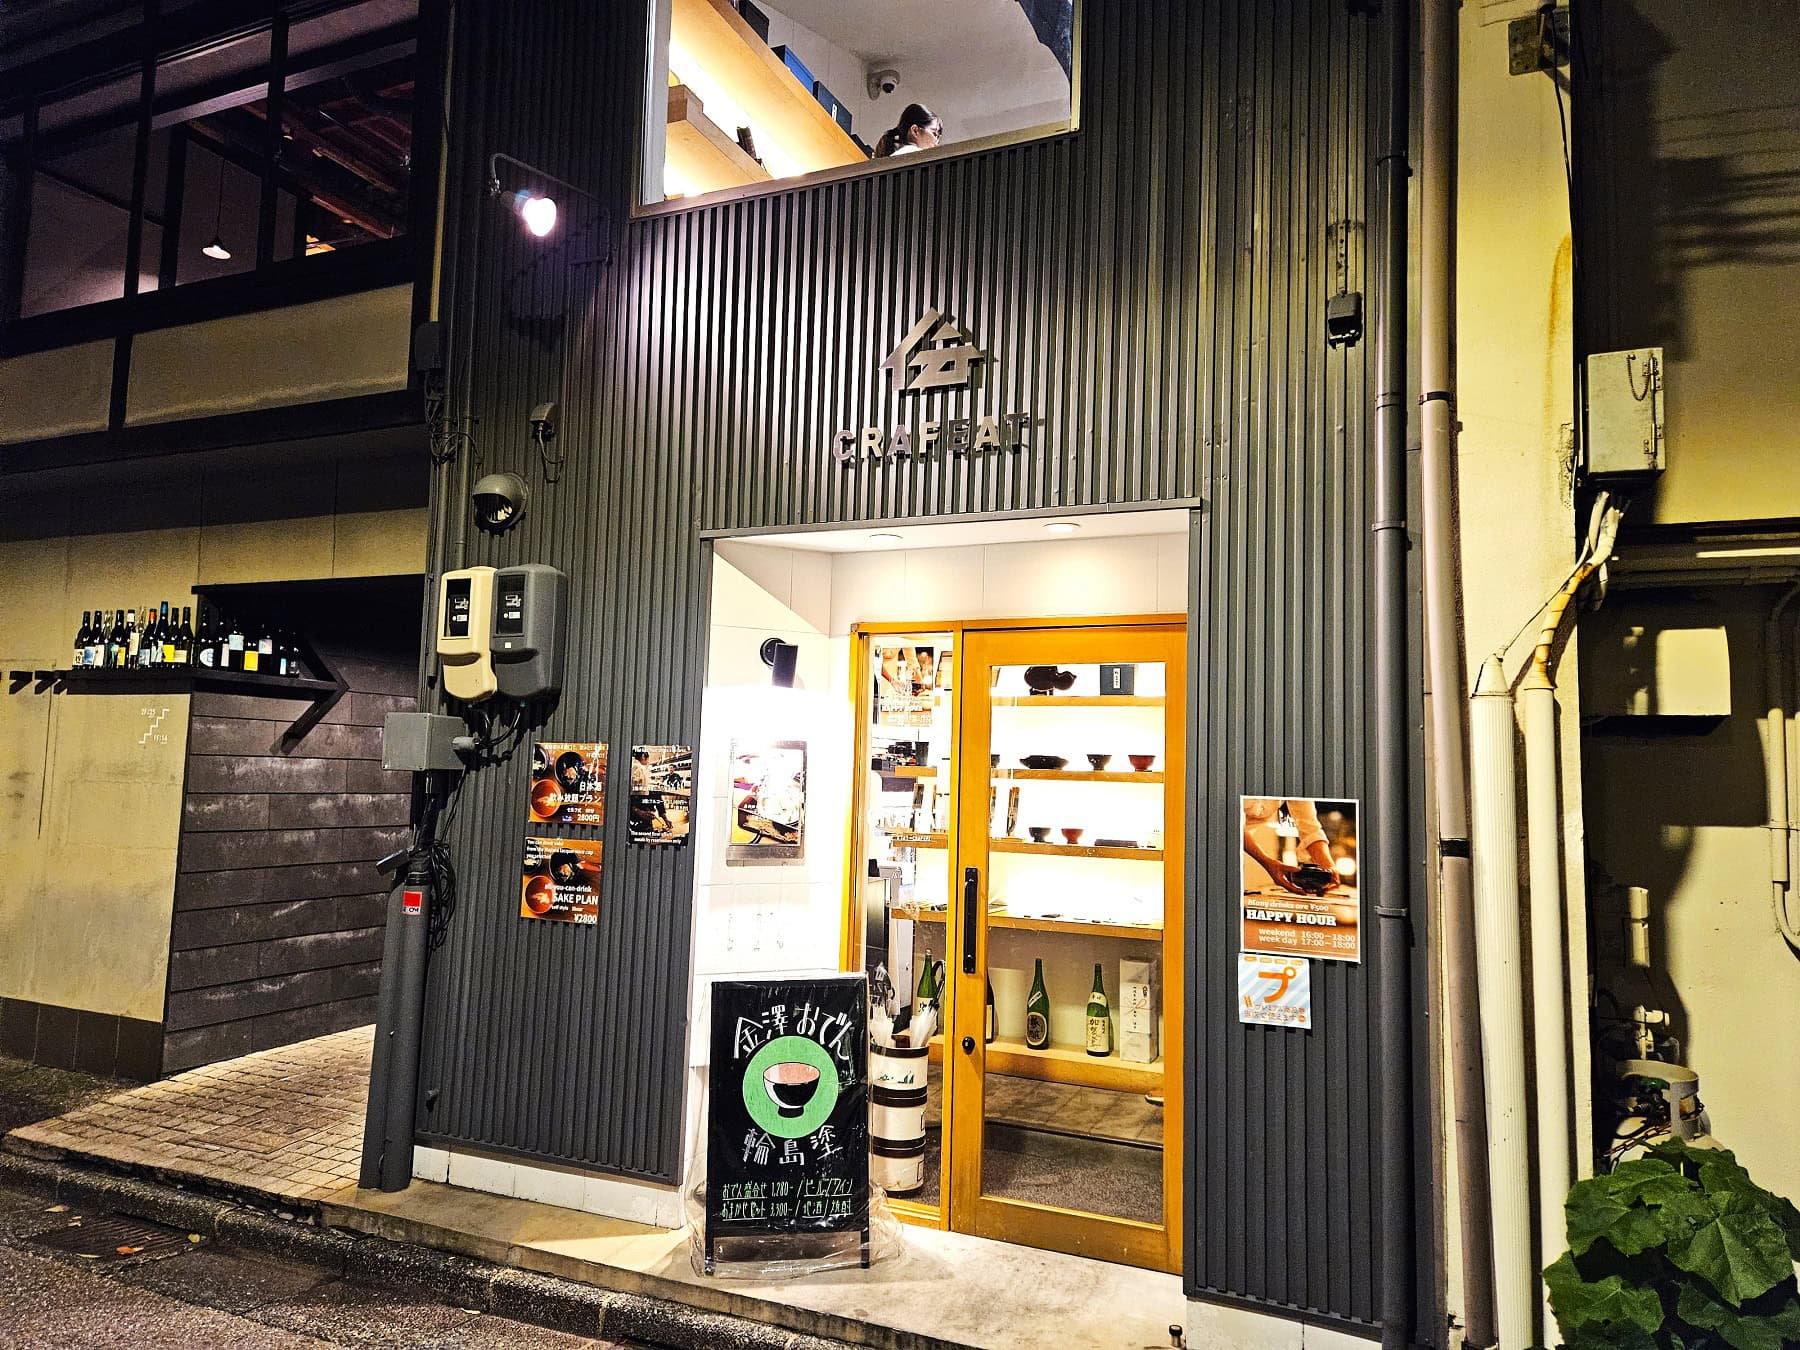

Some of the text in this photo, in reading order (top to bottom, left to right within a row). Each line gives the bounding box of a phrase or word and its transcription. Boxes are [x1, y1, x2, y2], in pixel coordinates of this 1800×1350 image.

[832, 412, 1029, 462] CRAFEAT
[549, 792, 601, 804] 飲み放題プラン
[577, 814, 600, 822] 2800円
[553, 893, 598, 905] SAKE PLAN
[1248, 899, 1269, 908] Many
[1270, 900, 1294, 908] drinks
[574, 913, 598, 924] ¥2800
[1246, 909, 1337, 926] HAPPY HOUR
[1258, 928, 1296, 937] weekend
[1258, 935, 1280, 943] week
[1281, 937, 1297, 945] day
[733, 1003, 853, 1060] 金澤おでん
[742, 1125, 843, 1166] 輪島塗
